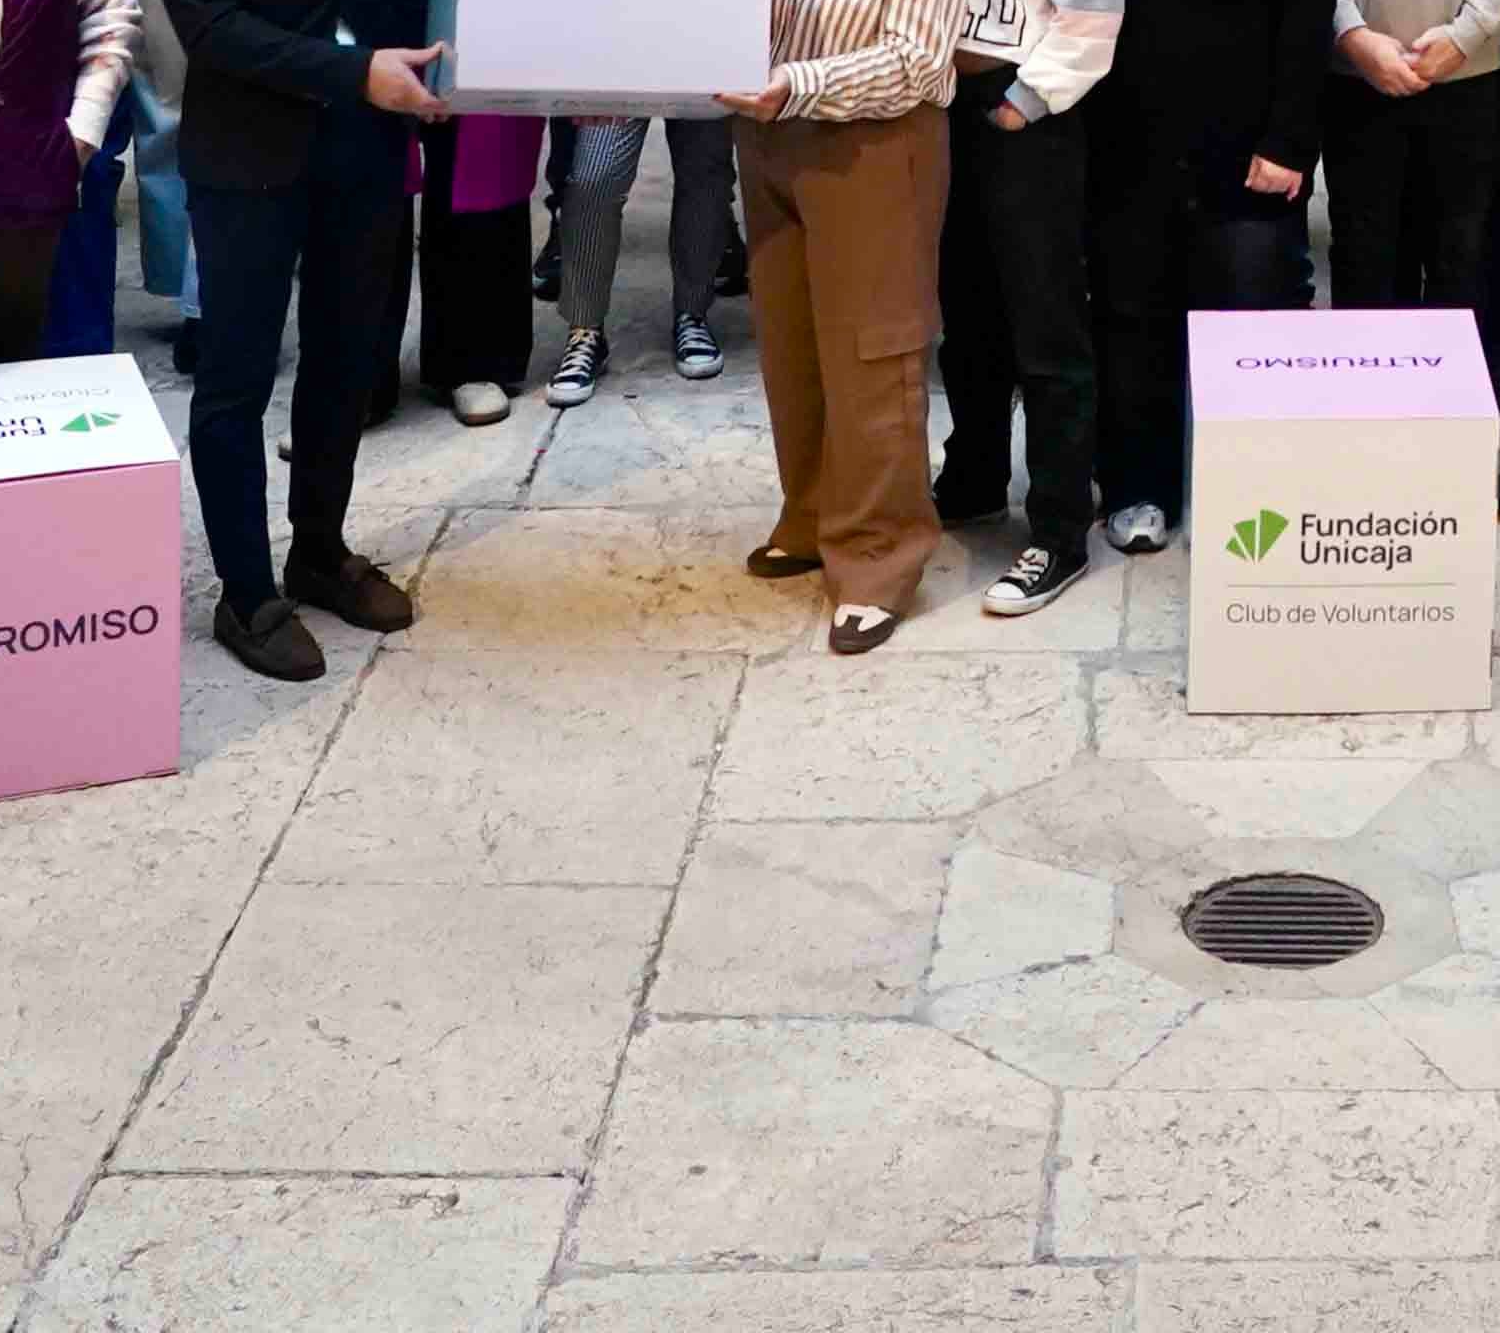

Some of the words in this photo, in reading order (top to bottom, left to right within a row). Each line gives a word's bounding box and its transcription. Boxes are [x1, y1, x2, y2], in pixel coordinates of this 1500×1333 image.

[1235, 355, 1445, 370] ALTRUISMO
[1300, 511, 1459, 537] Fundación
[1299, 539, 1413, 571] Unicaja
[1226, 602, 1282, 624] Club
[1286, 602, 1317, 624] de
[1322, 601, 1456, 624] Voluntarios
